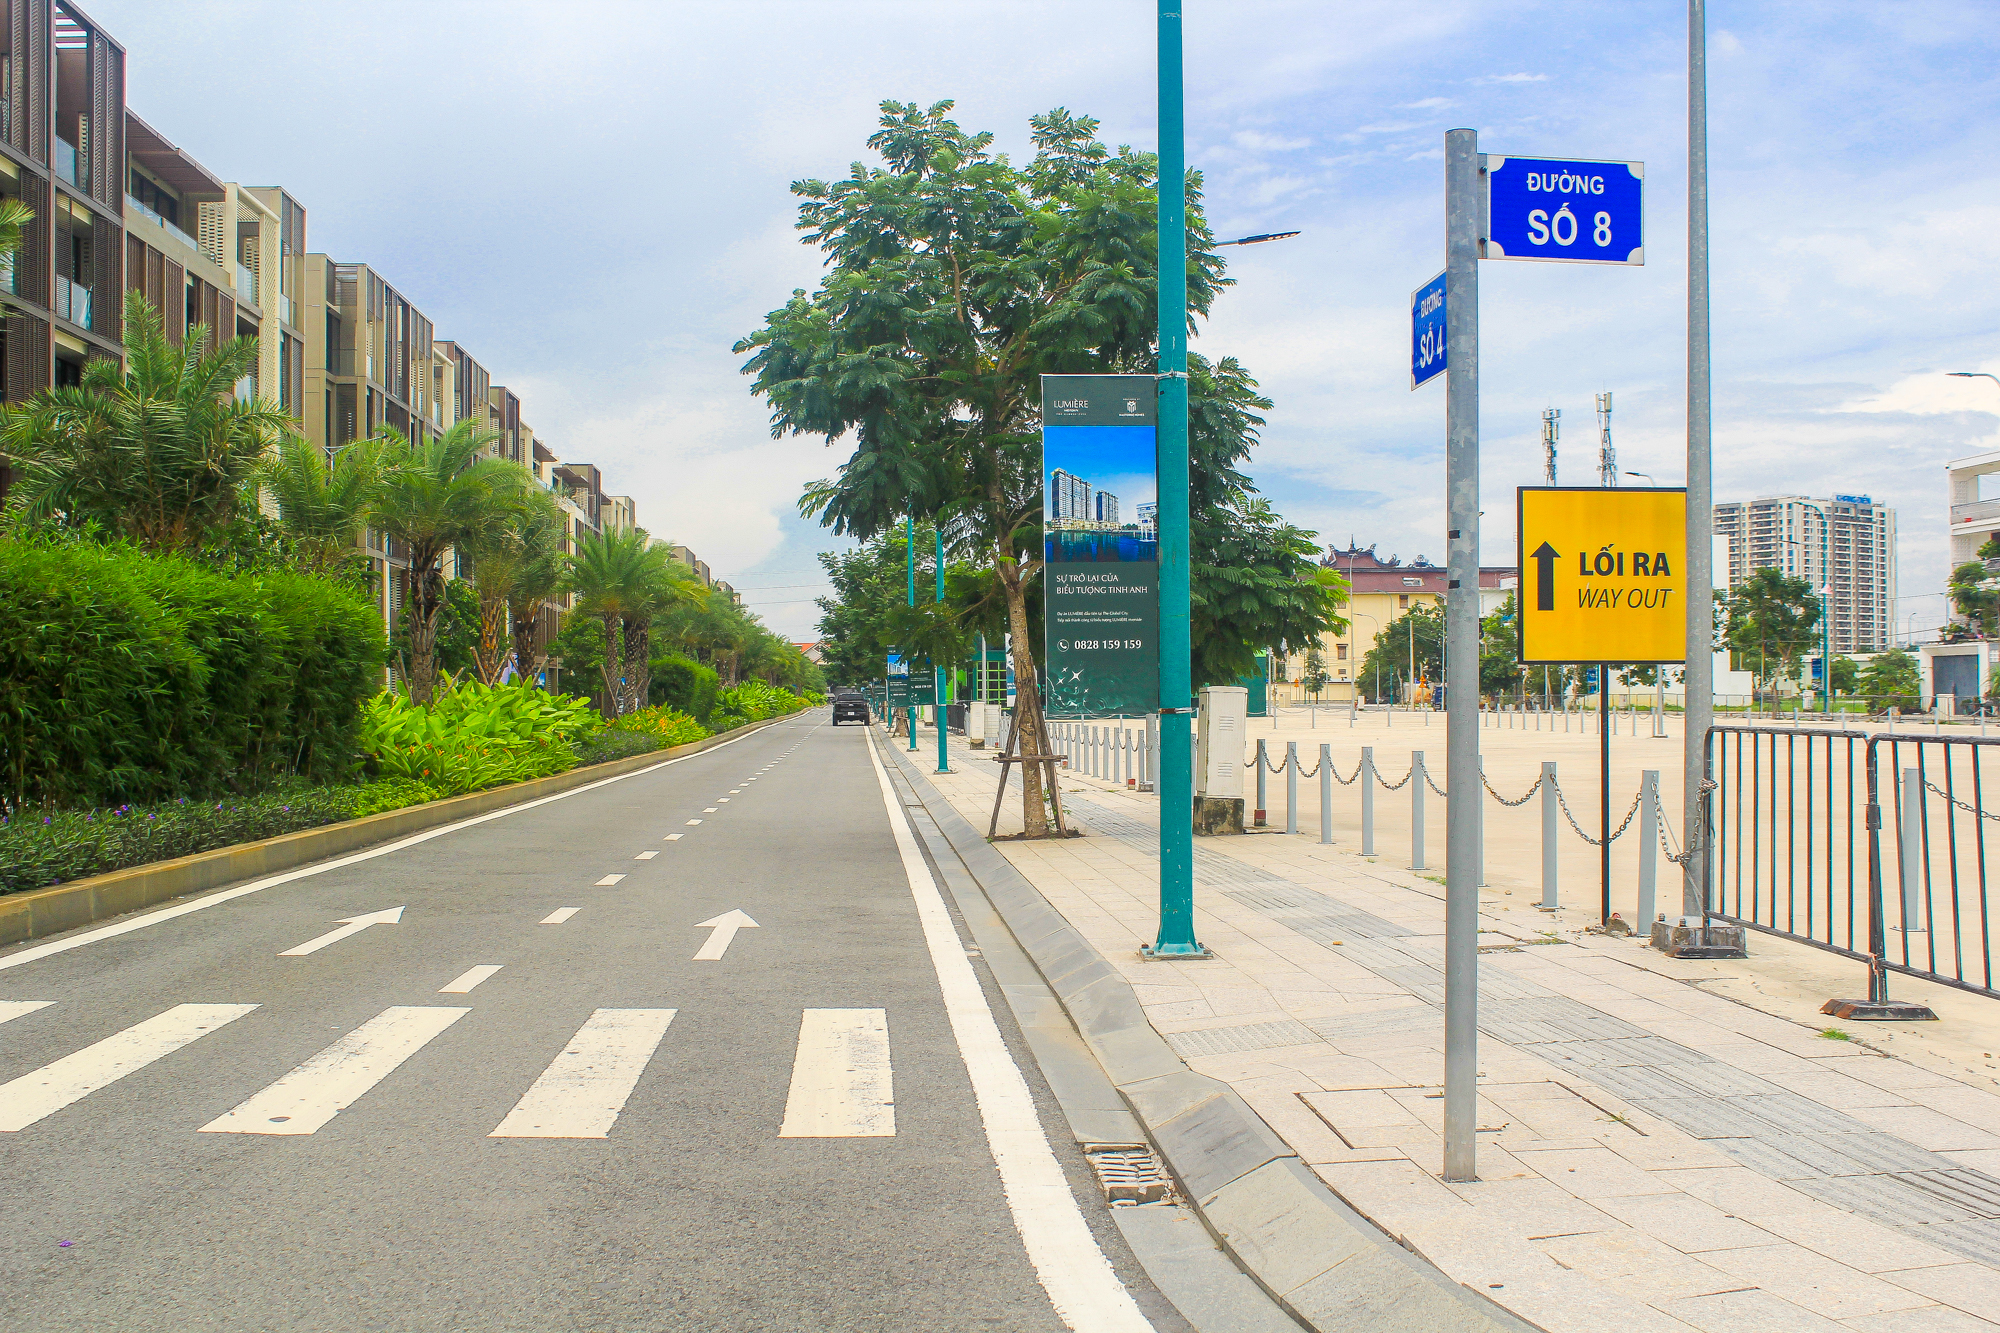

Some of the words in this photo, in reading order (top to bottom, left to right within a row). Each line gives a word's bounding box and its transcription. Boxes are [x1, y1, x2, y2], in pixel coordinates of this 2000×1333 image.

[1526, 169, 1605, 195] ĐƯỜNG
[1527, 202, 1578, 246] SỐ
[1593, 210, 1612, 247] 8
[1420, 288, 1442, 318] ĐƯỜNG
[1419, 322, 1434, 369] SỐ
[1436, 324, 1443, 360] 4
[1053, 398, 1089, 408] LUMIÈRE
[1579, 543, 1624, 576] LỐI
[1633, 552, 1671, 576] RA
[1056, 574, 1068, 583] SỰ
[1087, 574, 1099, 583] LẠI
[1101, 572, 1119, 582] CỦA
[1076, 585, 1107, 595] TƯỢNG
[1108, 586, 1128, 594] TINH
[1129, 586, 1148, 594] ANH
[1578, 588, 1624, 608] WAY
[1627, 588, 1673, 608] OUT
[1074, 640, 1099, 649] 0828
[1102, 640, 1120, 649] 159
[1124, 639, 1142, 649] 159
